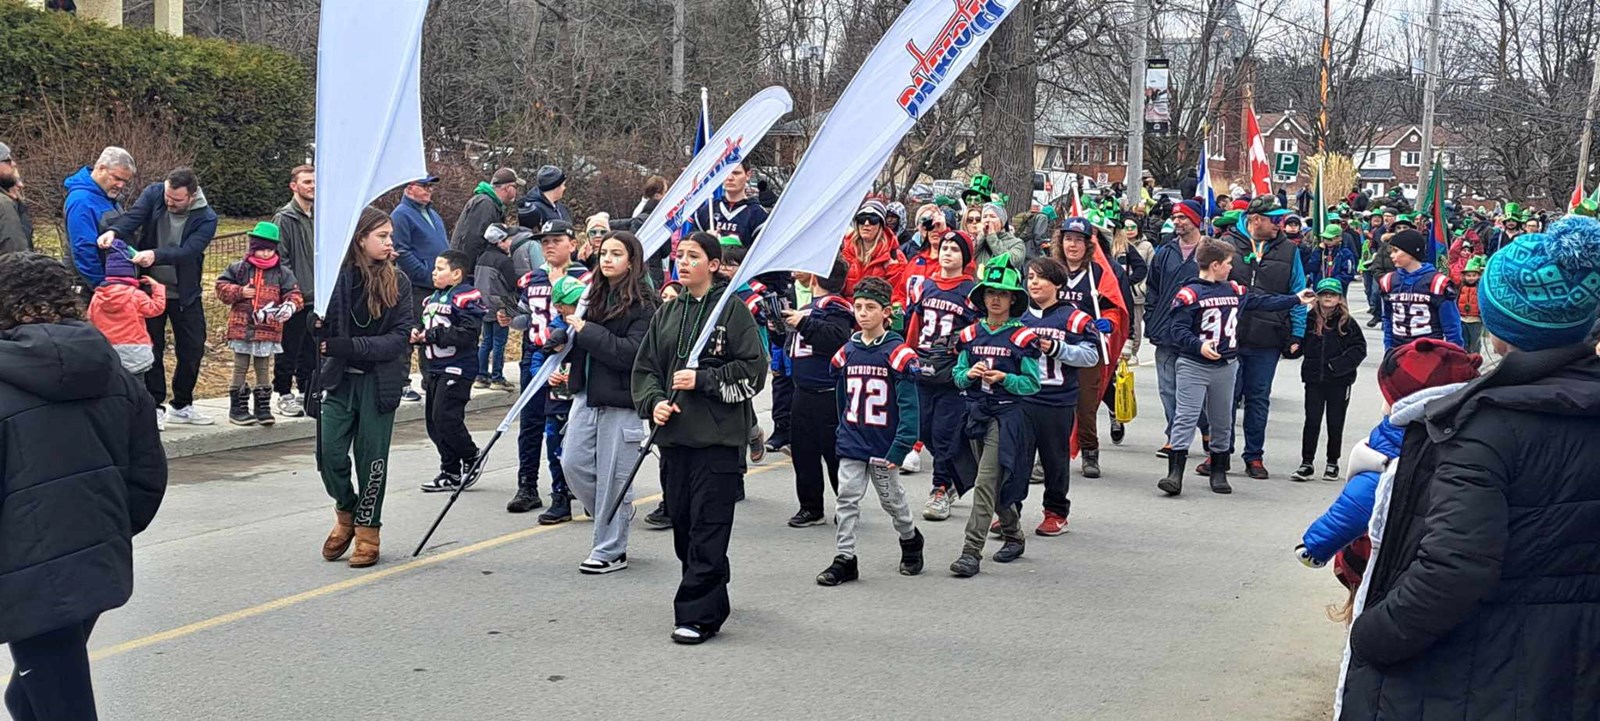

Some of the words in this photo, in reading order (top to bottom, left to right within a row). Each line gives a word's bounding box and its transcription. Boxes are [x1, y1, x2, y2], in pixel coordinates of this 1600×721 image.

[1280, 154, 1294, 170] P
[528, 286, 551, 296] PATRI
[1059, 291, 1083, 301] PATS
[1199, 296, 1240, 308] PATRIOTES
[528, 297, 558, 345] 5
[917, 309, 954, 348] 21
[1199, 307, 1239, 352] 94
[1392, 303, 1432, 337] 22
[847, 366, 888, 377] PATRIOTES
[847, 378, 888, 426] 72
